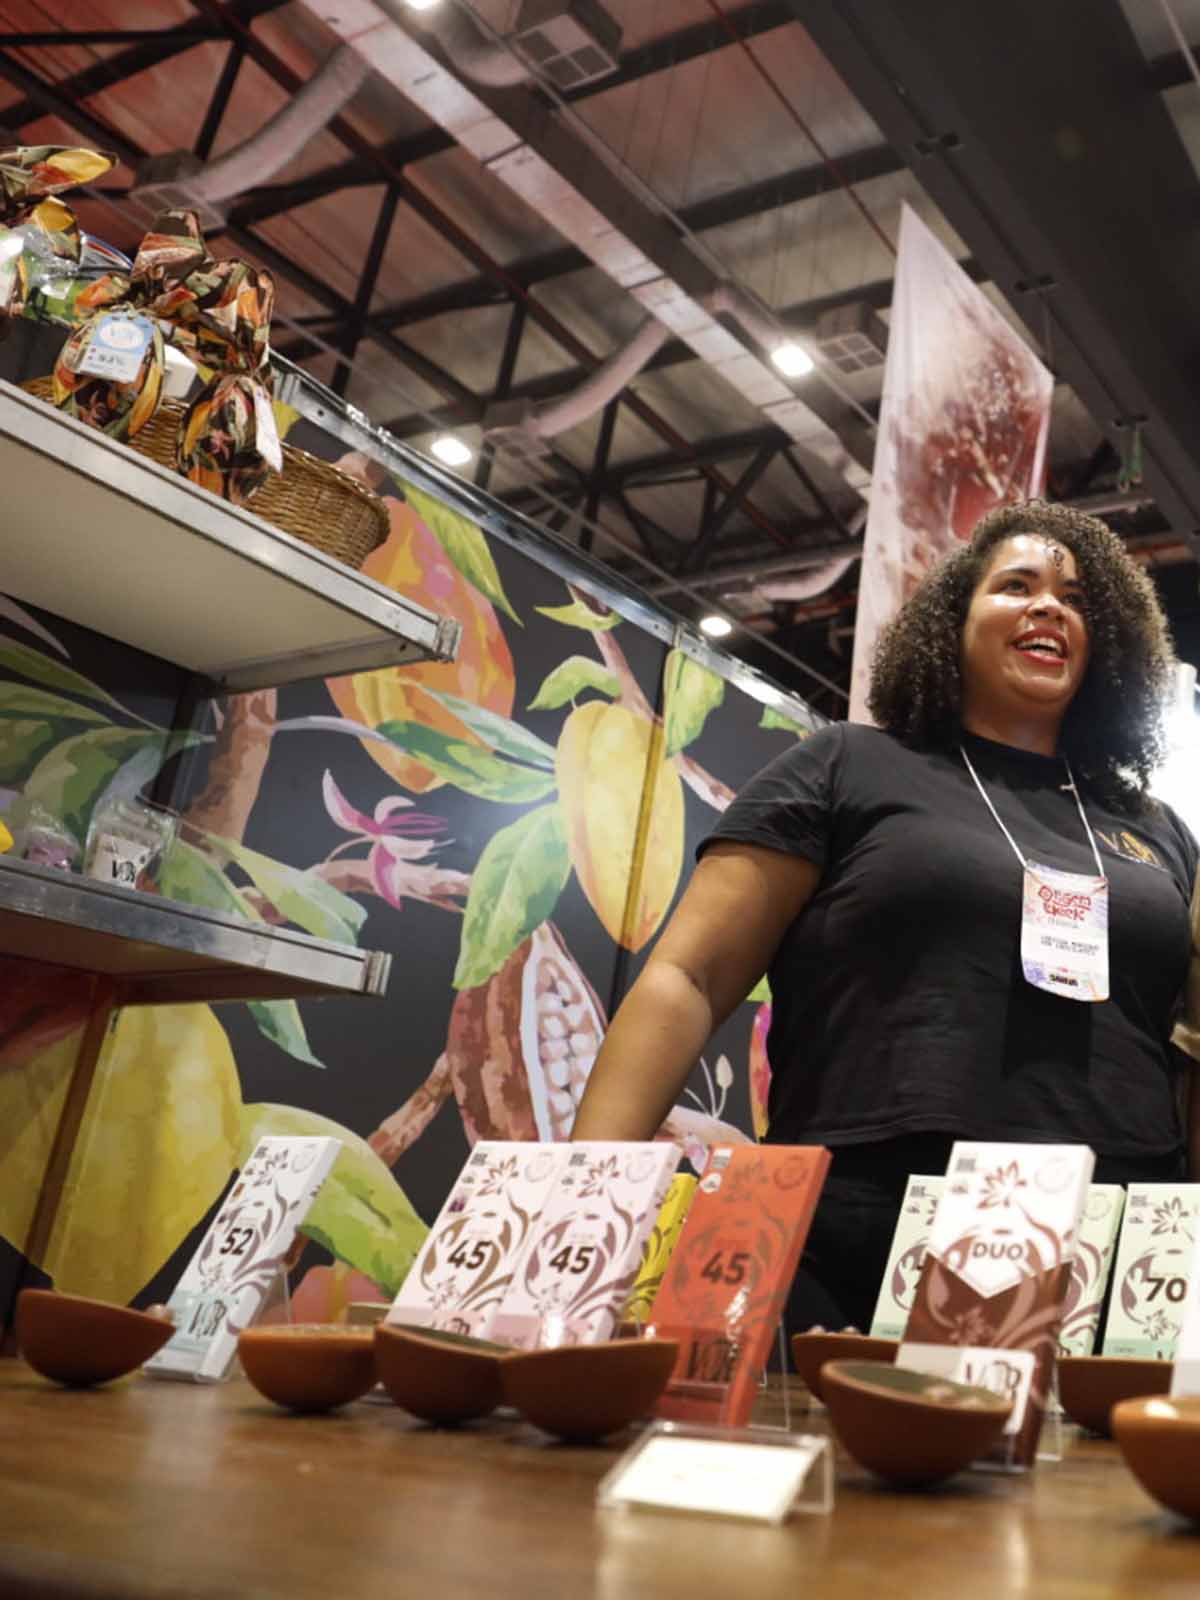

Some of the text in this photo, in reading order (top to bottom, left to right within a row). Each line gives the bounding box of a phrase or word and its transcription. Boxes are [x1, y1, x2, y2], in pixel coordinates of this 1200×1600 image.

[220, 1228, 253, 1255] 52
[447, 1240, 492, 1270] 45
[972, 1242, 1024, 1260] DUO
[549, 1245, 595, 1274] 45
[701, 1250, 749, 1285] 45
[1145, 1277, 1187, 1303] 70
